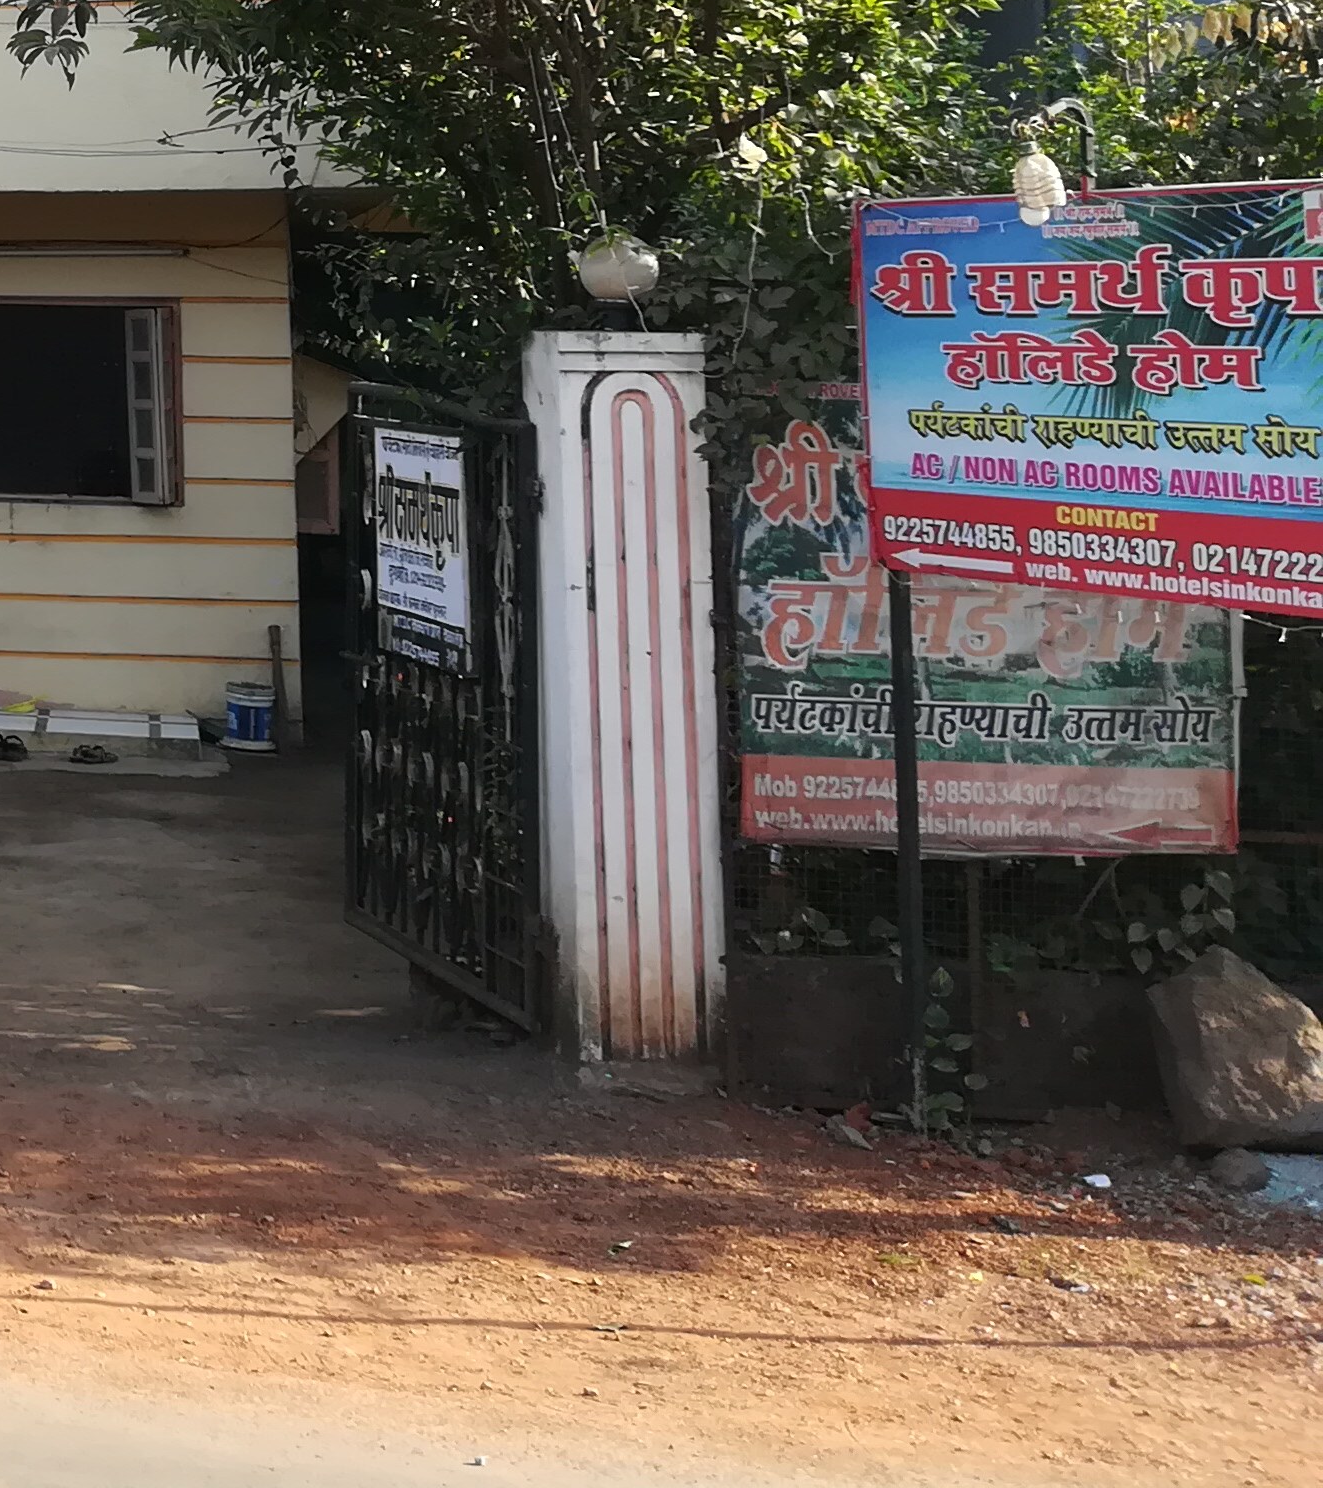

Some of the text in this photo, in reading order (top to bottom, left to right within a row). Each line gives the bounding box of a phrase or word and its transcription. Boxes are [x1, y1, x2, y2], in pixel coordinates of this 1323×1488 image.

[871, 244, 1323, 329] श्री समर्थ कृप
[941, 329, 1266, 394] हॉलिडे होम
[908, 399, 1323, 458] पर्यटकांची राहण्याची उत्तम सोय
[746, 419, 845, 527] श्री
[910, 452, 943, 481] AC
[963, 452, 1019, 487] NON
[1023, 458, 1059, 489] AC
[1064, 461, 1163, 497] ROOMS
[1168, 468, 1323, 507] AVAILABLE
[1056, 505, 1159, 532] CONTACT
[1025, 562, 1079, 582] web.
[1063, 704, 1148, 746] उत्तम
[1151, 693, 1219, 745] सोय
[754, 773, 798, 799] Mob
